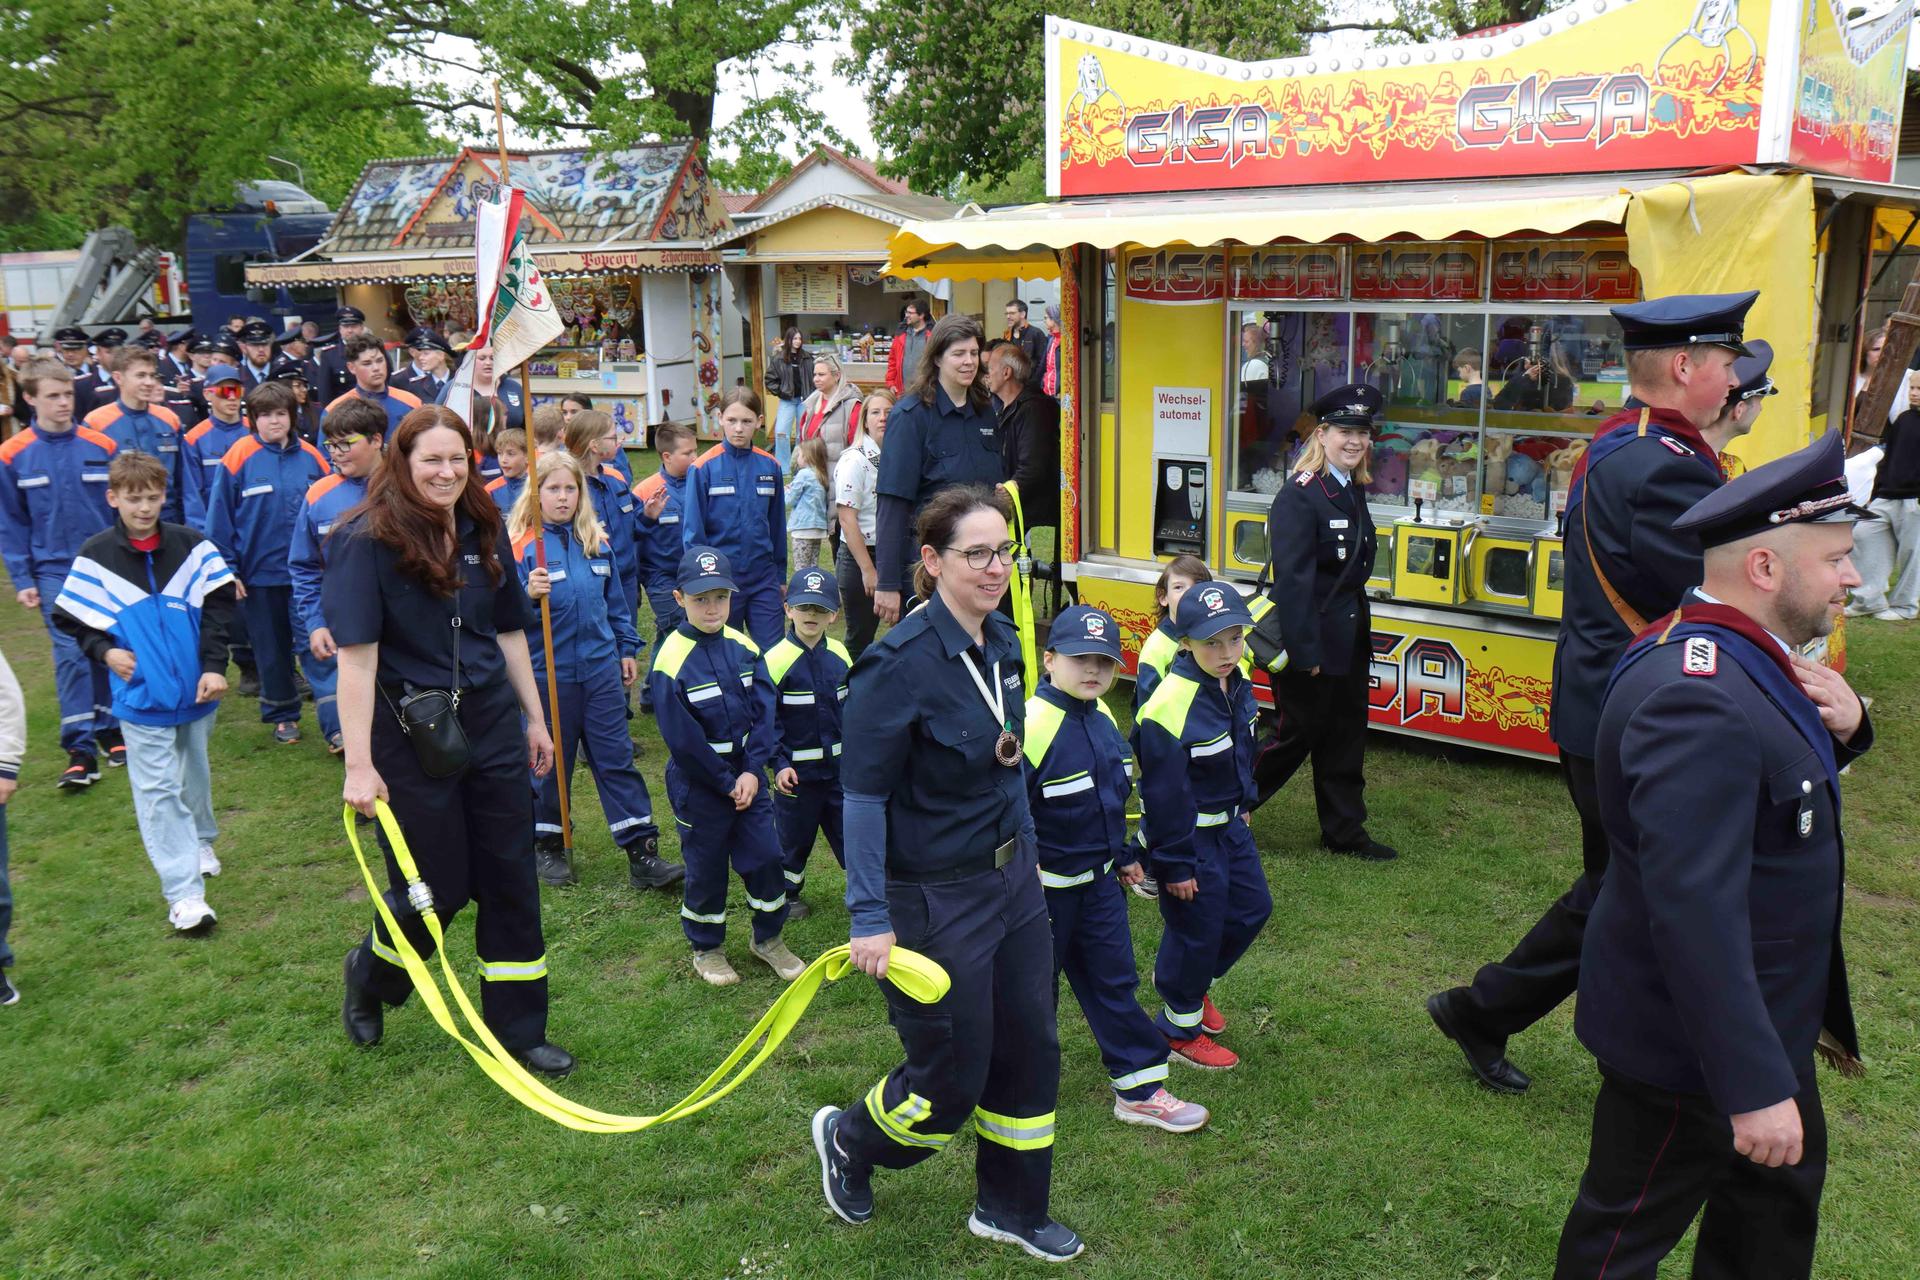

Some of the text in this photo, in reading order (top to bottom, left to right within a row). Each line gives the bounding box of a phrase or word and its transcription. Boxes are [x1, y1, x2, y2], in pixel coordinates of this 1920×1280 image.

[1456, 72, 1649, 150] GIGA
[1126, 103, 1269, 170] GIGA
[581, 252, 638, 268] Popcorn
[1356, 249, 1477, 296] GIGA
[1497, 247, 1633, 297] GIGA
[1158, 393, 1206, 405] Wechsel-
[1159, 409, 1201, 420] automat
[1368, 631, 1466, 725] GA
